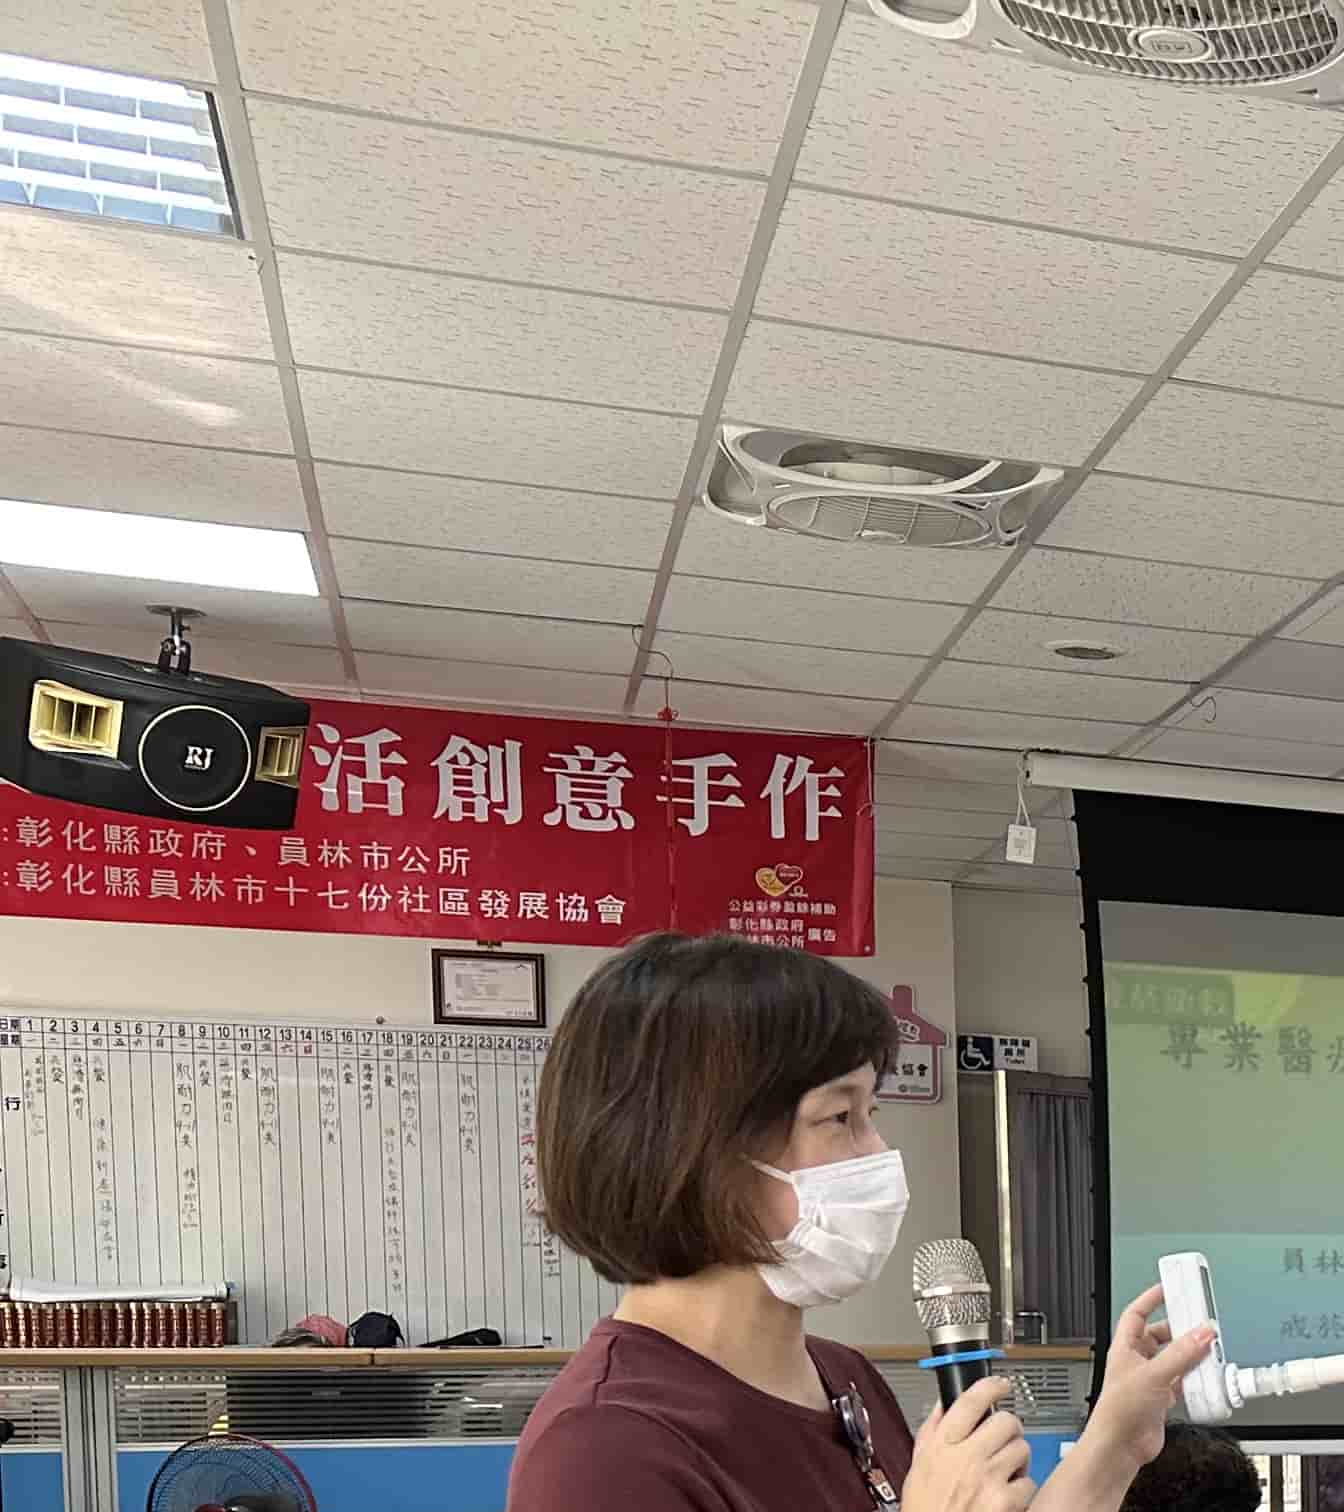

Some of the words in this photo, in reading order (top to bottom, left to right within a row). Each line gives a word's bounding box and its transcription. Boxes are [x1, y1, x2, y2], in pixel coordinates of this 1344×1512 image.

[185, 745, 214, 770] RJ
[309, 721, 849, 841] 活創意手作
[729, 917, 804, 932] 彰化縣政府
[808, 928, 837, 942] 廣告
[26, 1019, 33, 1031] 1
[50, 1020, 57, 1032] 2
[72, 1021, 79, 1033] 3
[92, 1022, 100, 1033] 4
[114, 1023, 122, 1034] 5
[135, 1023, 143, 1034] 6
[157, 1024, 164, 1036] 7
[178, 1025, 186, 1037] 8
[199, 1026, 206, 1037] 9
[218, 1027, 230, 1038] 10
[239, 1027, 249, 1038] 11
[259, 1028, 271, 1039] 12
[280, 1029, 291, 1040] 13
[301, 1030, 312, 1041] 14
[321, 1031, 333, 1041] 15
[342, 1031, 353, 1042] 16
[362, 1032, 373, 1043] 17
[382, 1032, 393, 1044] 18
[402, 1034, 413, 1046] 19
[420, 1035, 434, 1046] 20
[440, 1035, 452, 1046] 21
[459, 1036, 473, 1048] 22
